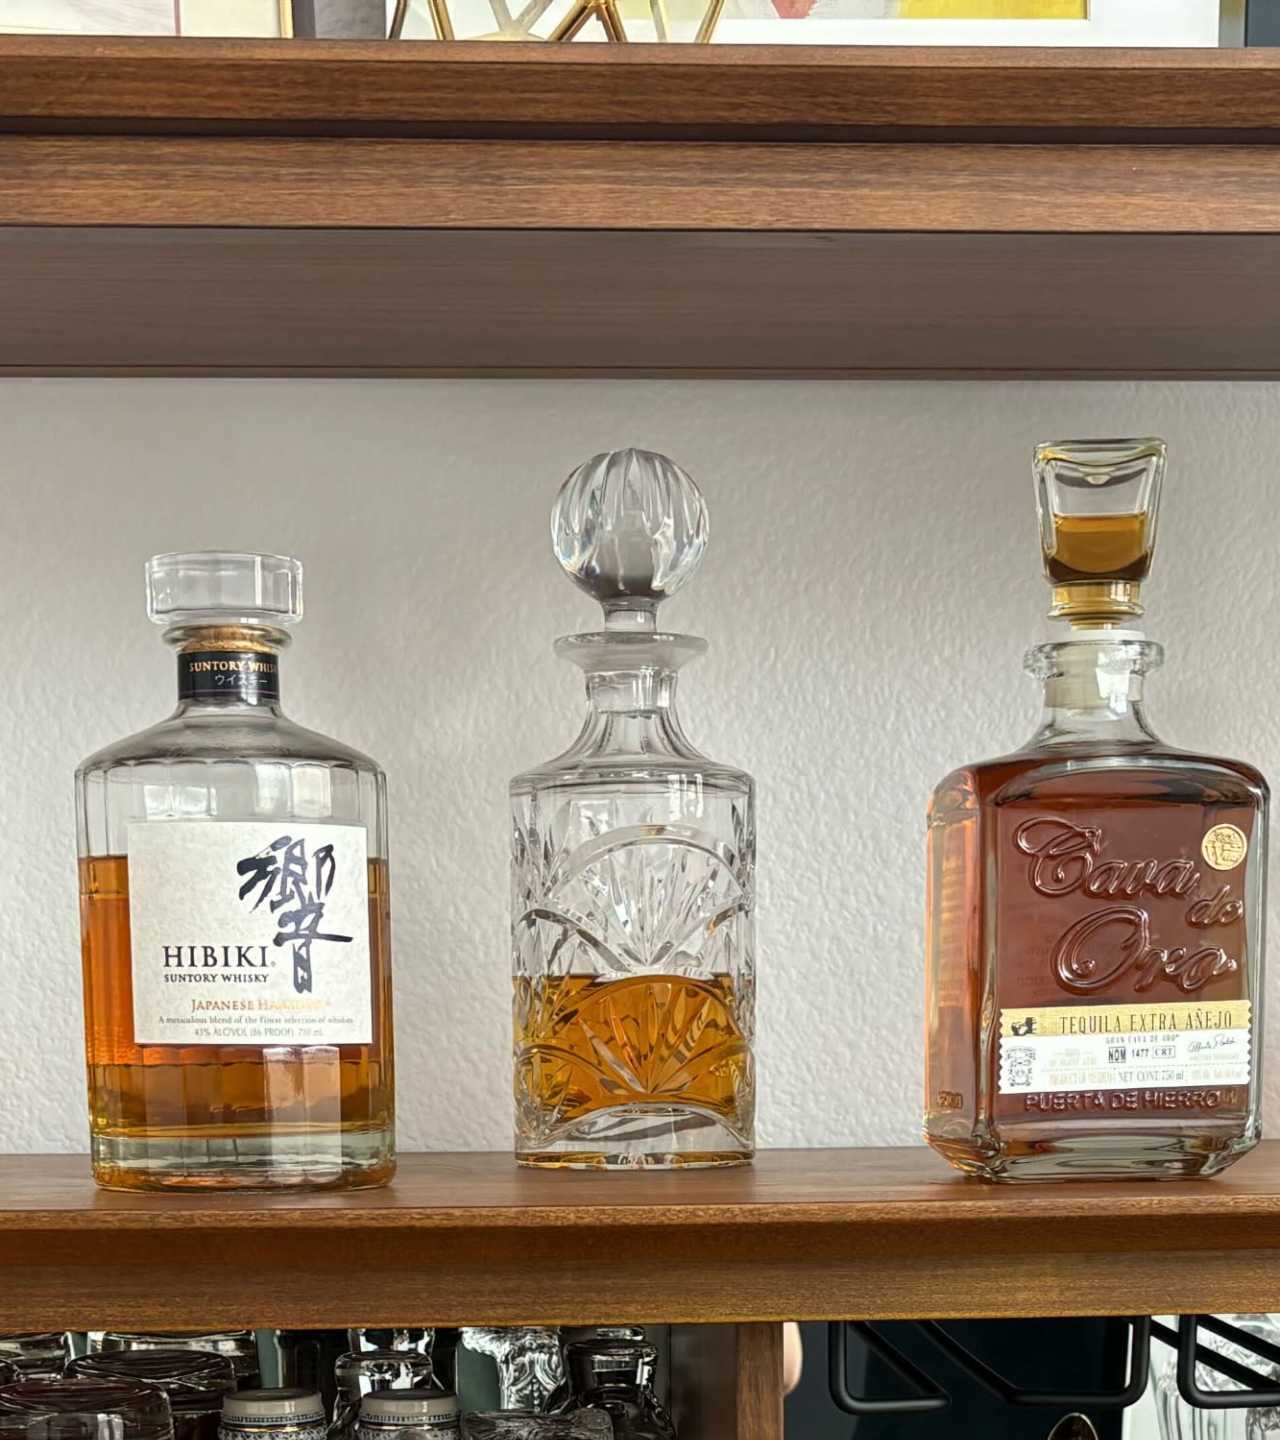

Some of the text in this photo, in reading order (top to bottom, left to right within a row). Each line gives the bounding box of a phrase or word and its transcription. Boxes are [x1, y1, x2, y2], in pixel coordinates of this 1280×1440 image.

[189, 660, 279, 673] SUNTORY WHIS
[236, 835, 355, 994] 響
[162, 945, 269, 968] HIBIKI
[163, 973, 269, 984] SUNTORY WHISKY
[191, 999, 255, 1013] JAPANESE
[1060, 1008, 1233, 1035] TEQUILA EXTRA AÑEJO
[1109, 1048, 1126, 1062] NOM
[1026, 1091, 1105, 1111] PUERTA
[1111, 1091, 1138, 1109] DE
[1145, 1090, 1221, 1109] HIERRO
